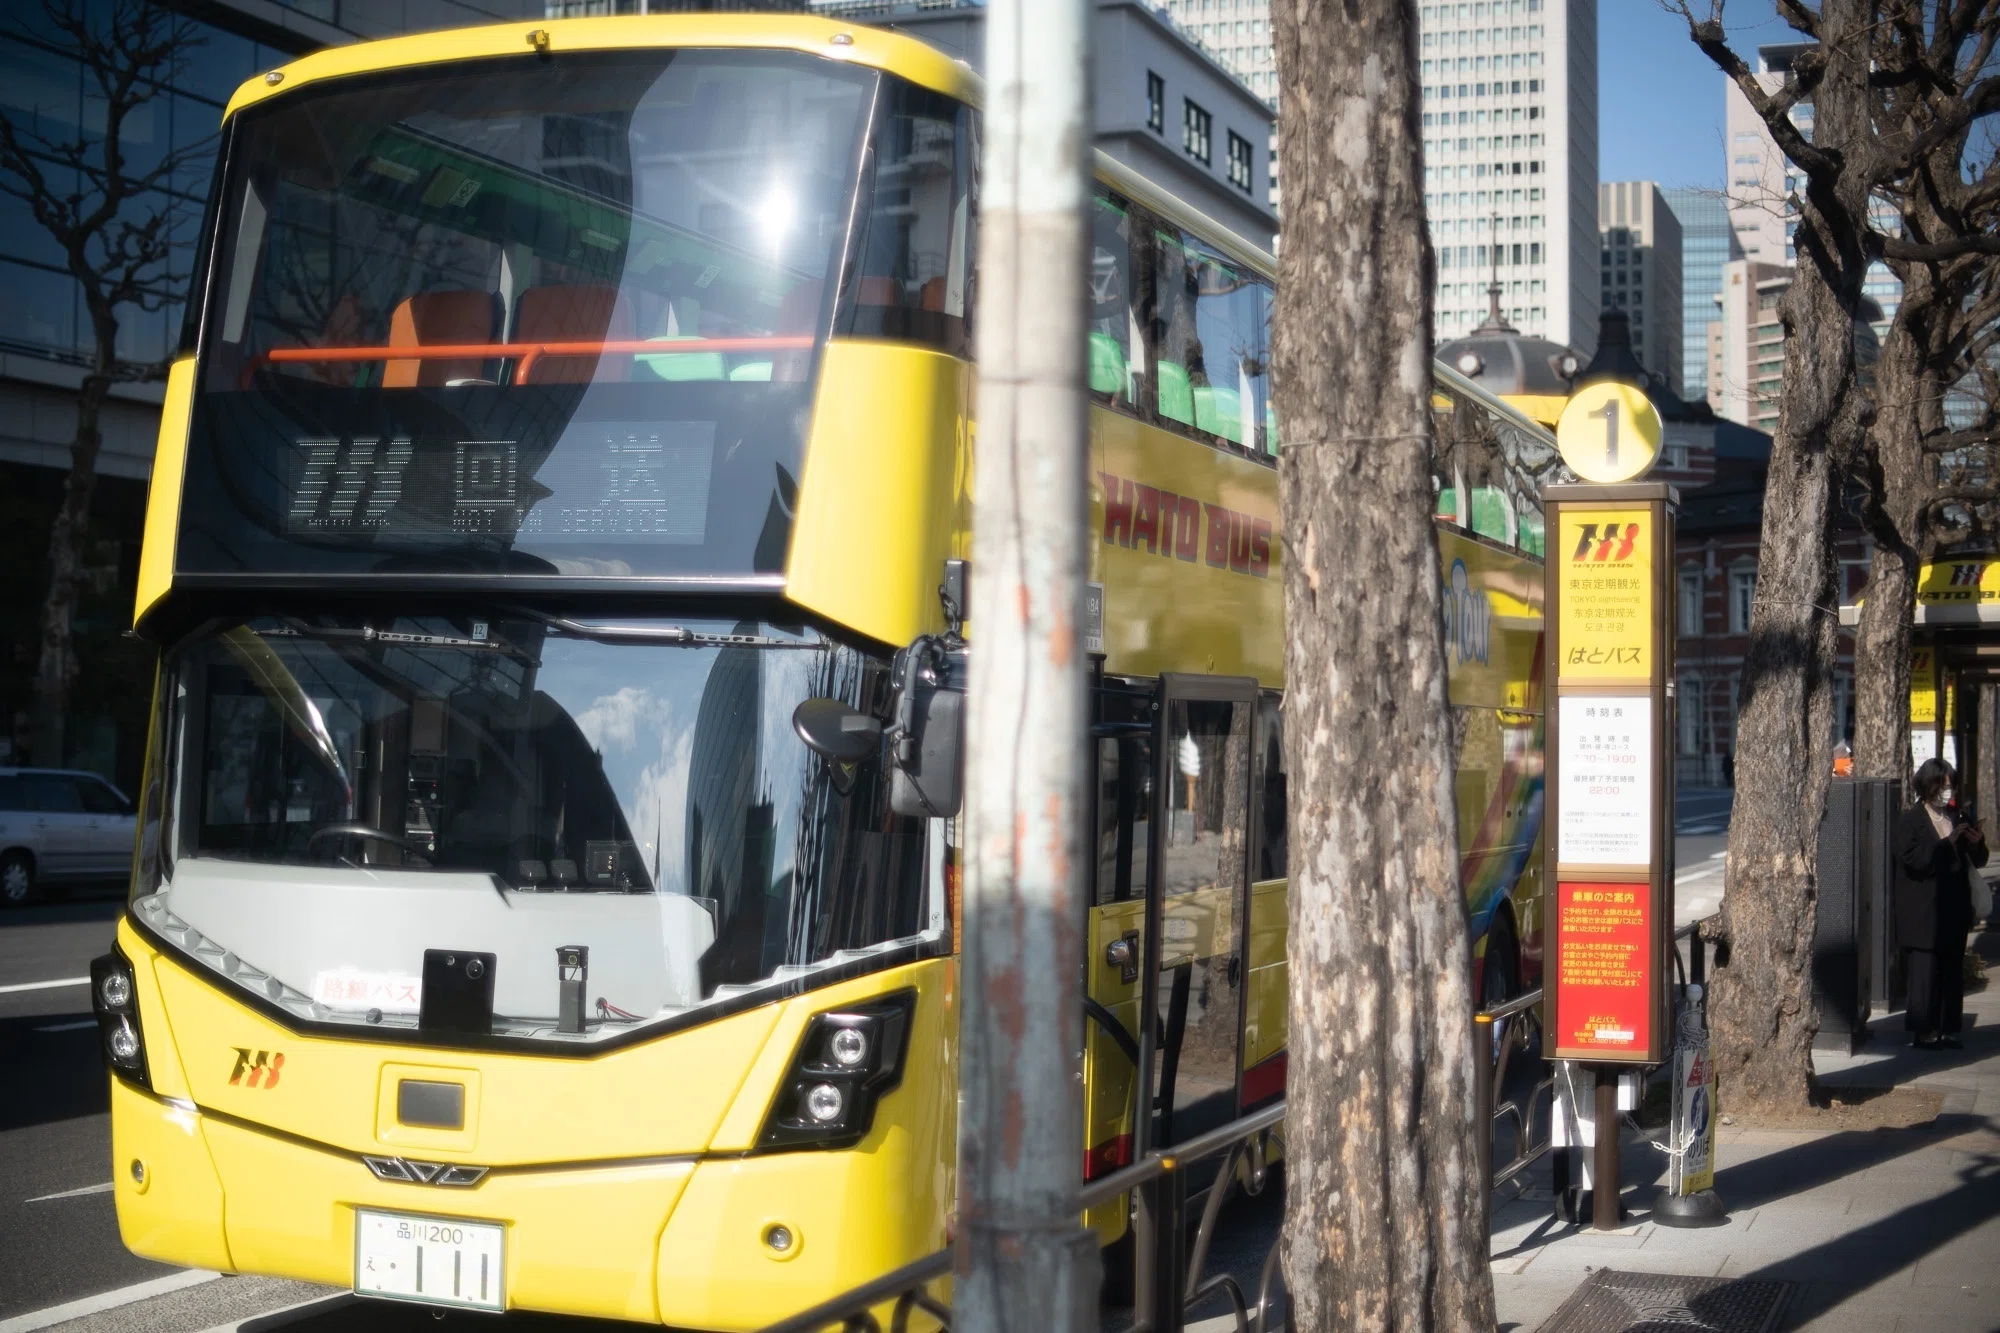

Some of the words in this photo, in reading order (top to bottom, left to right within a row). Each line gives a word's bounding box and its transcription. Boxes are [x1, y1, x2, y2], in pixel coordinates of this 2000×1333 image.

[1588, 399, 1619, 467] 1
[453, 509, 496, 532] NOT
[516, 509, 542, 532] IN
[562, 509, 668, 532] SERVICE
[1097, 471, 1200, 564] HATO
[1203, 502, 1272, 579] BUS
[1569, 578, 1641, 590] 東京定期観光
[1569, 595, 1597, 604] TOKYO
[1567, 646, 1642, 664] はとバス
[1585, 707, 1623, 718] 時刻表
[1589, 786, 1620, 795] 22:00
[1572, 891, 1635, 903] 乗車のご案内
[323, 978, 417, 1003] 路線バス
